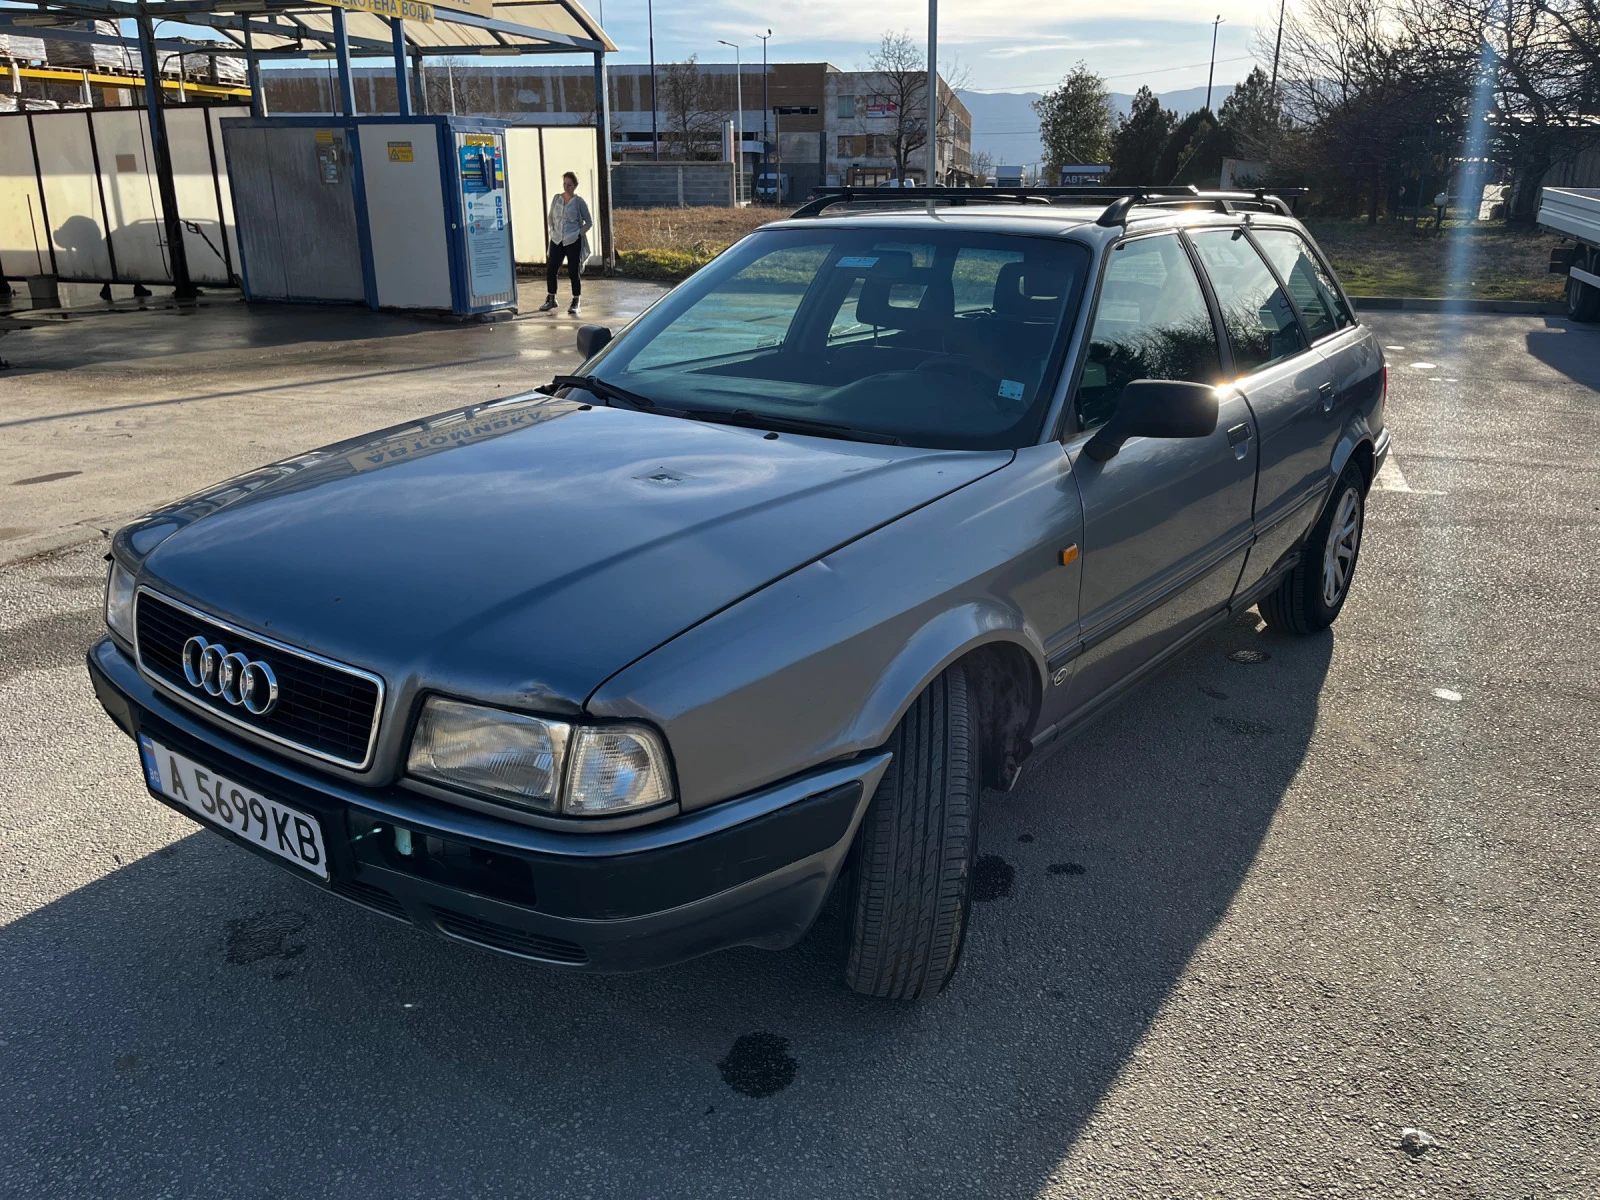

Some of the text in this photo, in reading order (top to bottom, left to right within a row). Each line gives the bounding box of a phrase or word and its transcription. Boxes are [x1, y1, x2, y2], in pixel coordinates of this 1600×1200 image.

[402, 1, 433, 21] ВОДА
[194, 769, 269, 842] 5699
[271, 806, 320, 867] KB
